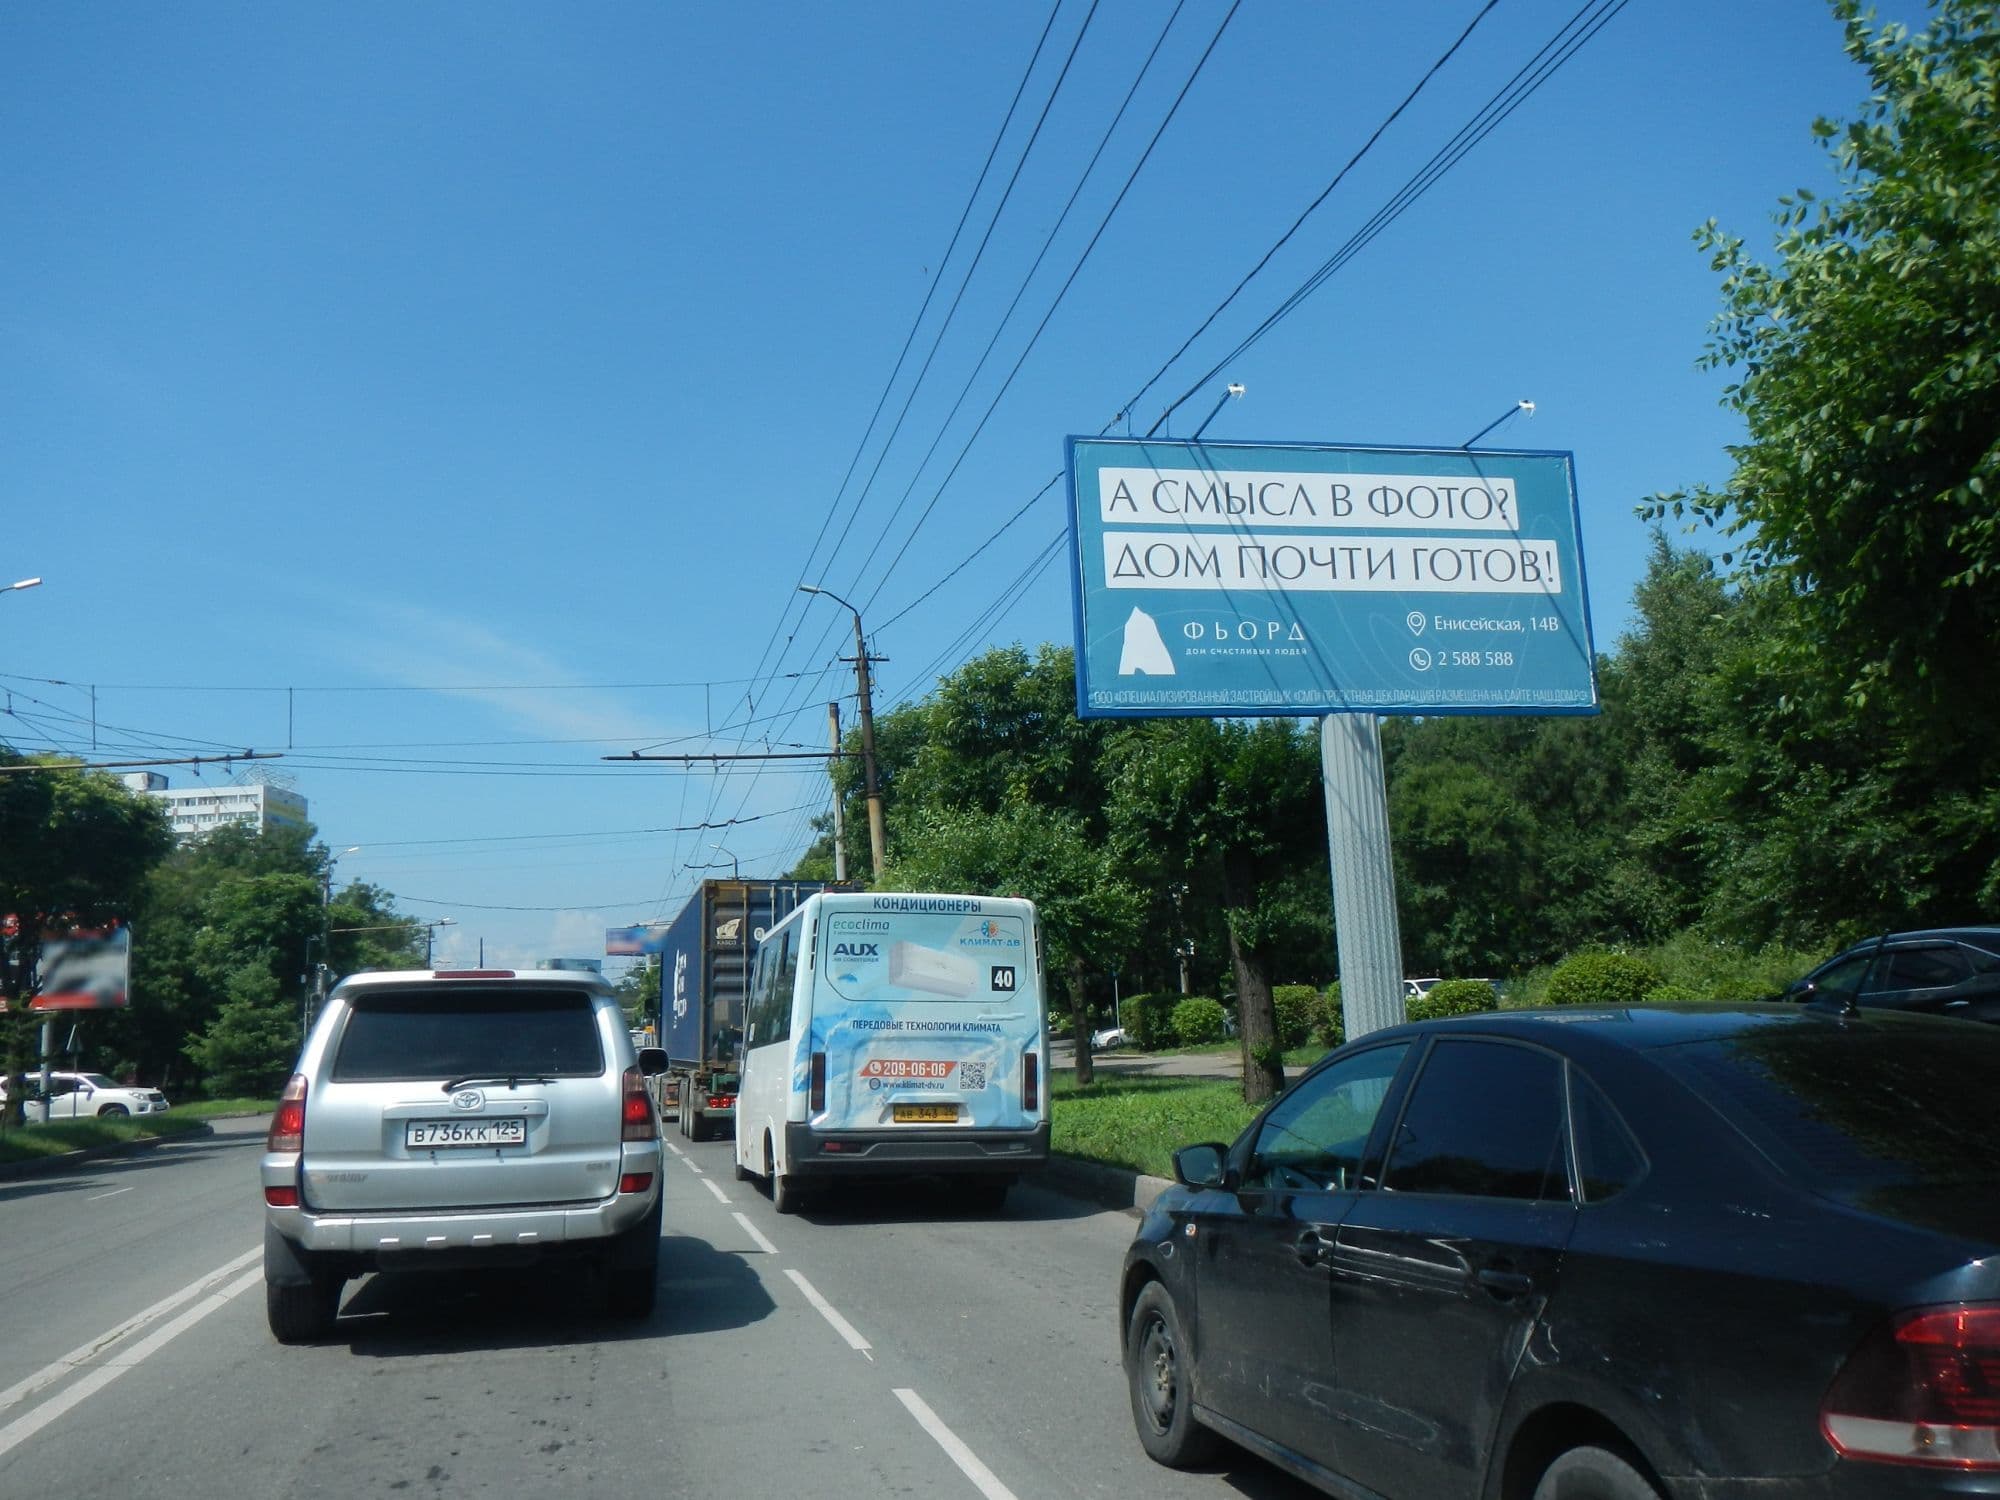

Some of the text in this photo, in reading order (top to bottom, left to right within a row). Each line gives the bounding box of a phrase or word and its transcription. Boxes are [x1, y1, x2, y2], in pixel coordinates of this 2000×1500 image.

[1109, 478, 1509, 520] А СМЫСЛ В ФОТО?
[1112, 543, 1554, 583] ДОМ ПОЧТИ ГОТОВ!
[1183, 621, 1305, 641] ФЬОРД
[1434, 615, 1559, 633] Енисейская, 14В
[1438, 652, 1514, 666] 2 588 588
[873, 897, 981, 912] КОНДИЦИОНЕРЫ
[833, 919, 890, 930] ecoclima
[833, 943, 879, 956] AUX
[994, 970, 1014, 988] 40
[852, 1020, 1001, 1033] ПЕРЕДОВЫЕ ТЕХНОЛОГИИ КЛИМАТА
[883, 1062, 946, 1077] 209-06-06
[492, 1121, 519, 1136] 125
